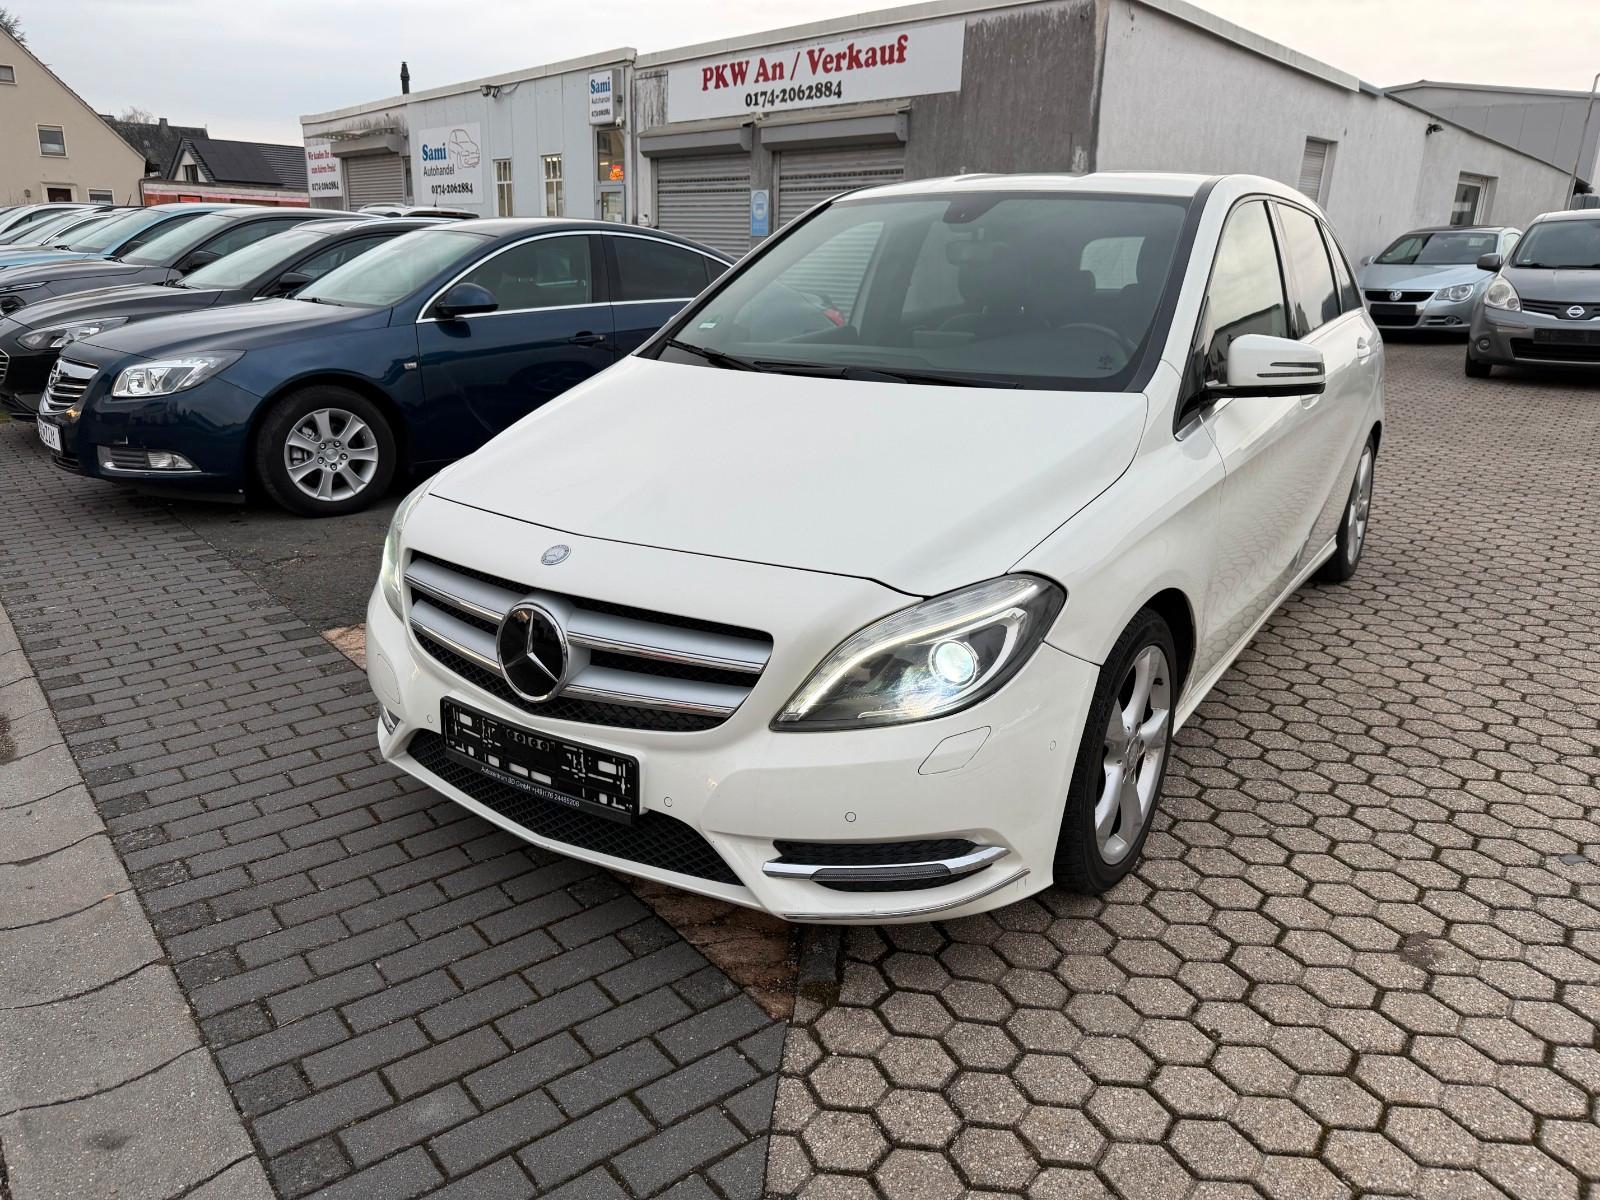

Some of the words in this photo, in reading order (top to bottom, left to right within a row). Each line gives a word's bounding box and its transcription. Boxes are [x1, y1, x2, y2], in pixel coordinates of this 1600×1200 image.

[701, 60, 750, 92] PKW
[754, 57, 785, 84] An
[790, 51, 802, 80] /
[806, 34, 909, 76] Verkauf
[590, 76, 611, 95] Sami
[745, 80, 842, 108] 0174-2062884
[421, 142, 447, 161] Sami
[423, 163, 455, 177] Autohandel
[431, 182, 474, 195] 0174-2062884
